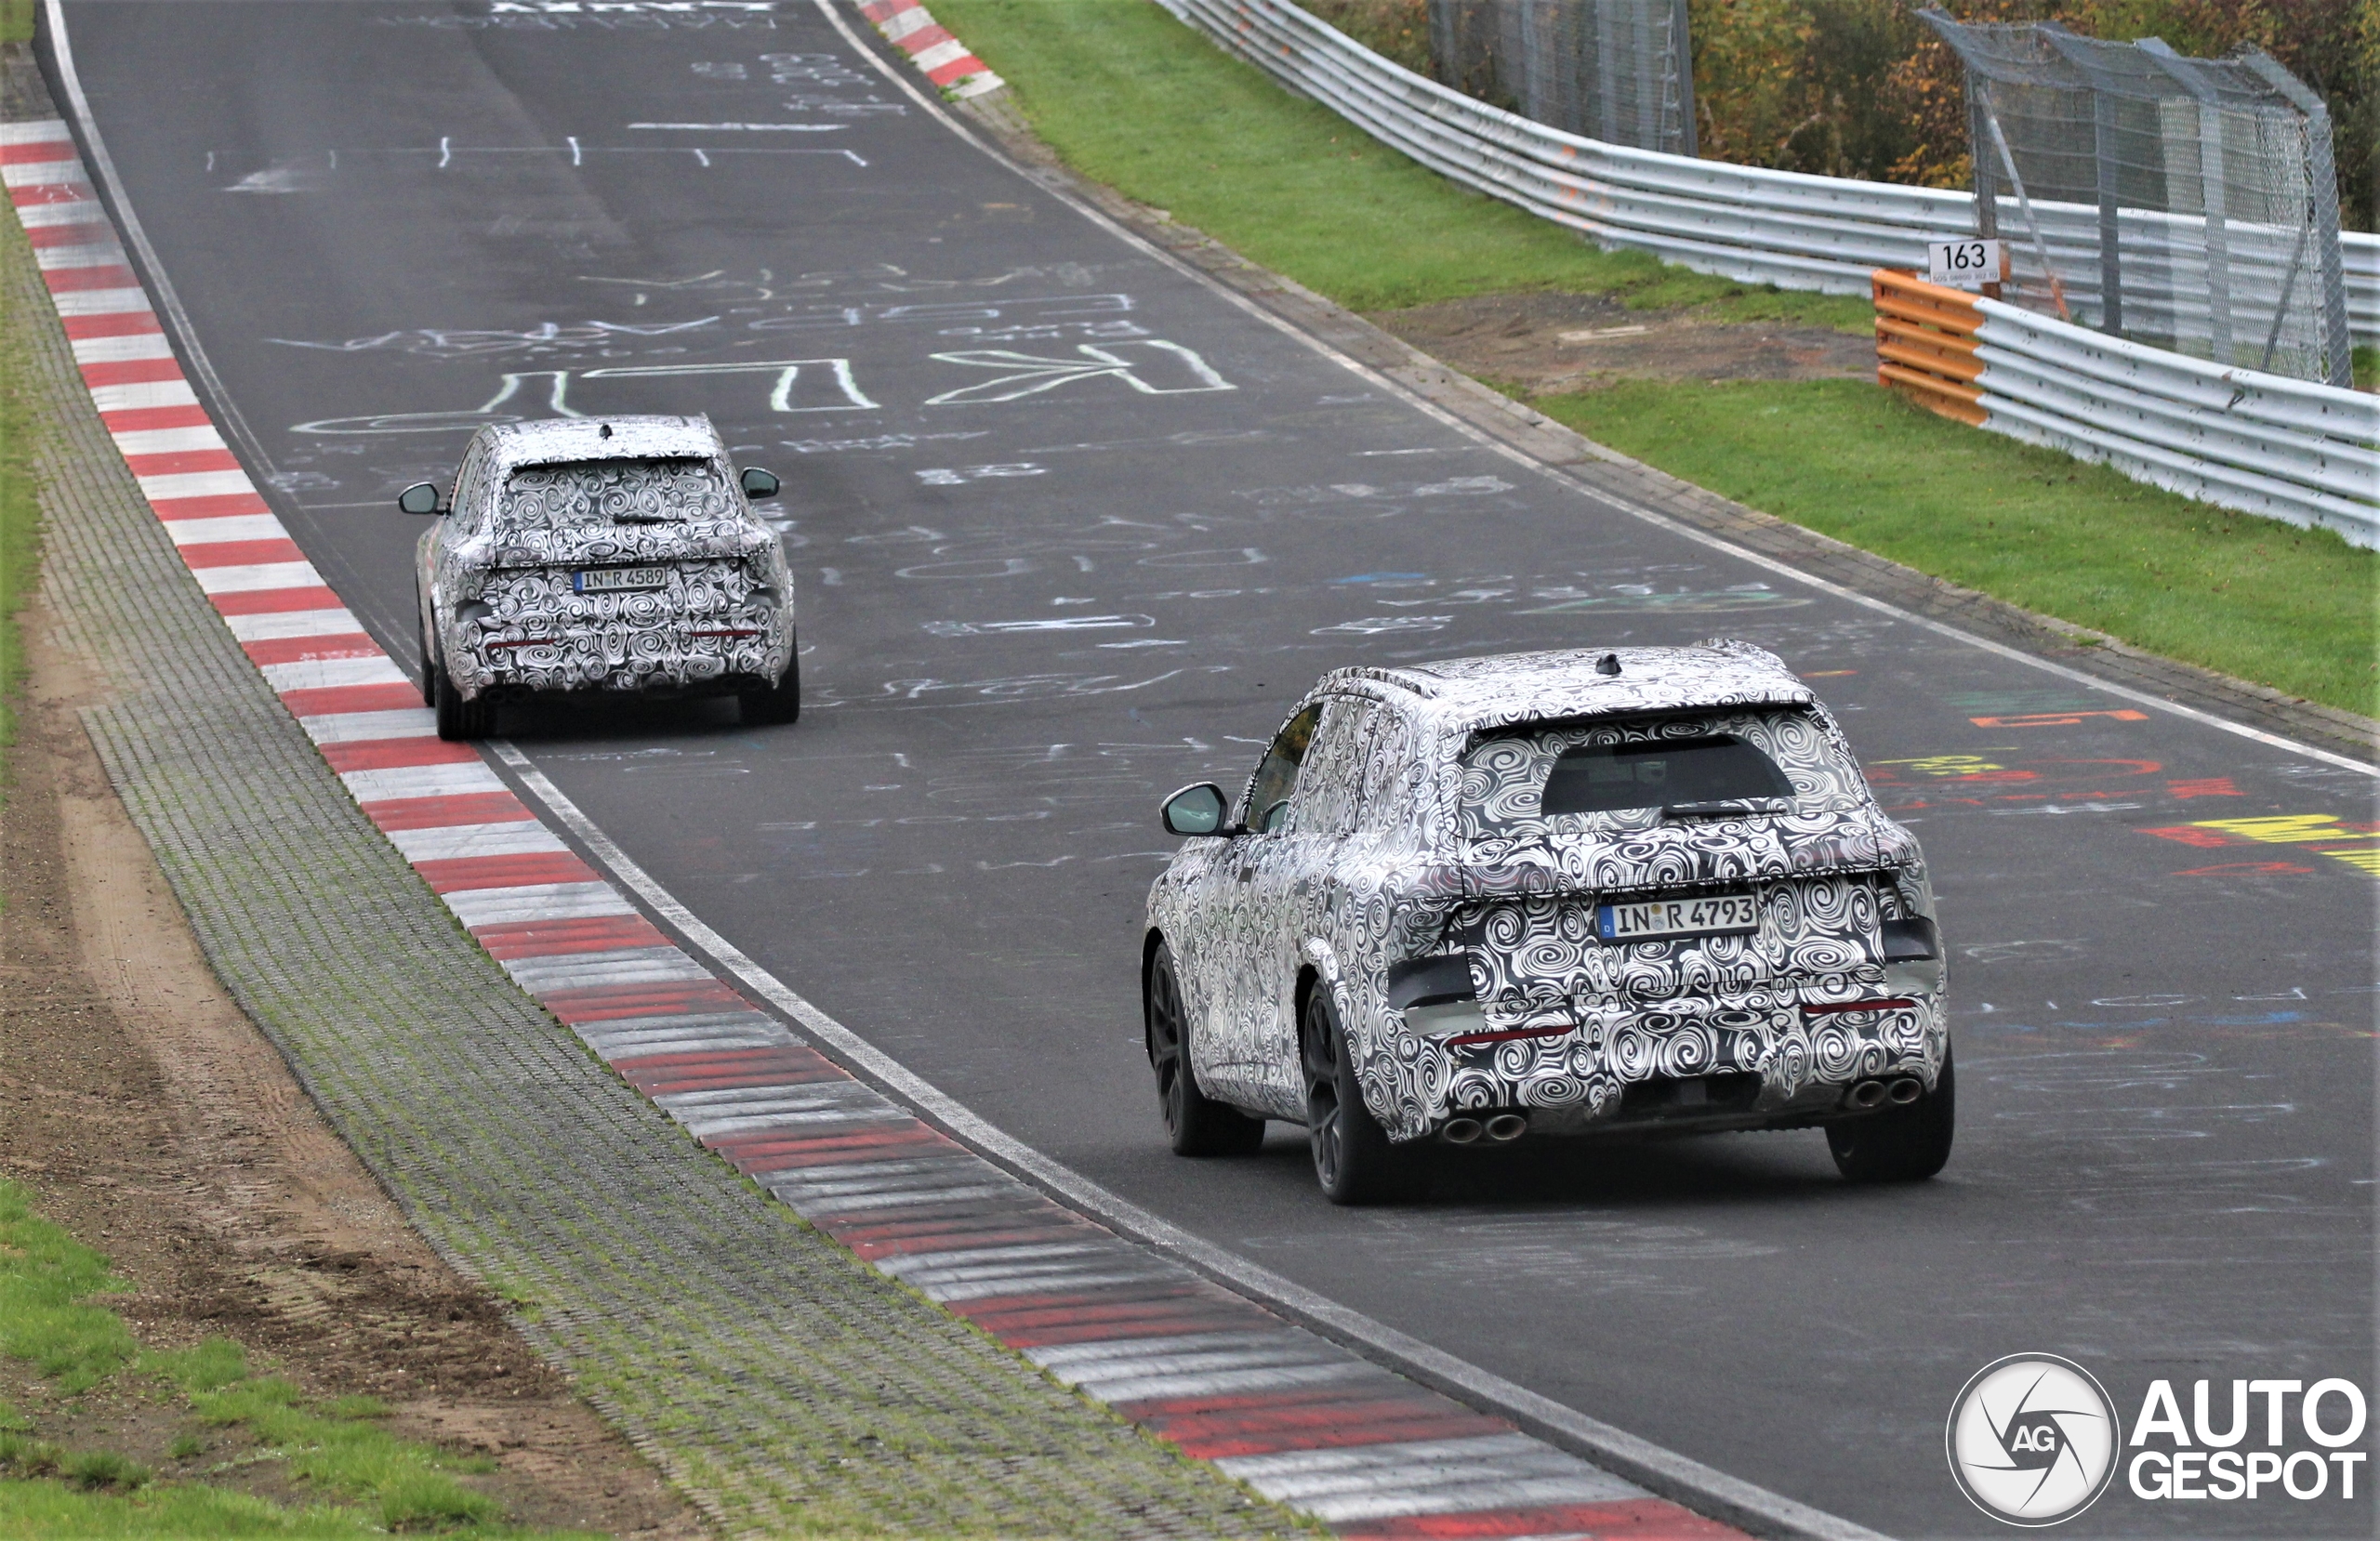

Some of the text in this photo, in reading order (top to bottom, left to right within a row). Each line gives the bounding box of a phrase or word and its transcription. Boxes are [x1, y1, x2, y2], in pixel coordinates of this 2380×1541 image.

[1943, 244, 1986, 270] 163
[585, 569, 664, 587] IN R 4589
[1619, 906, 1650, 933] IN
[1667, 904, 1685, 929] R
[1690, 898, 1753, 927] 4793
